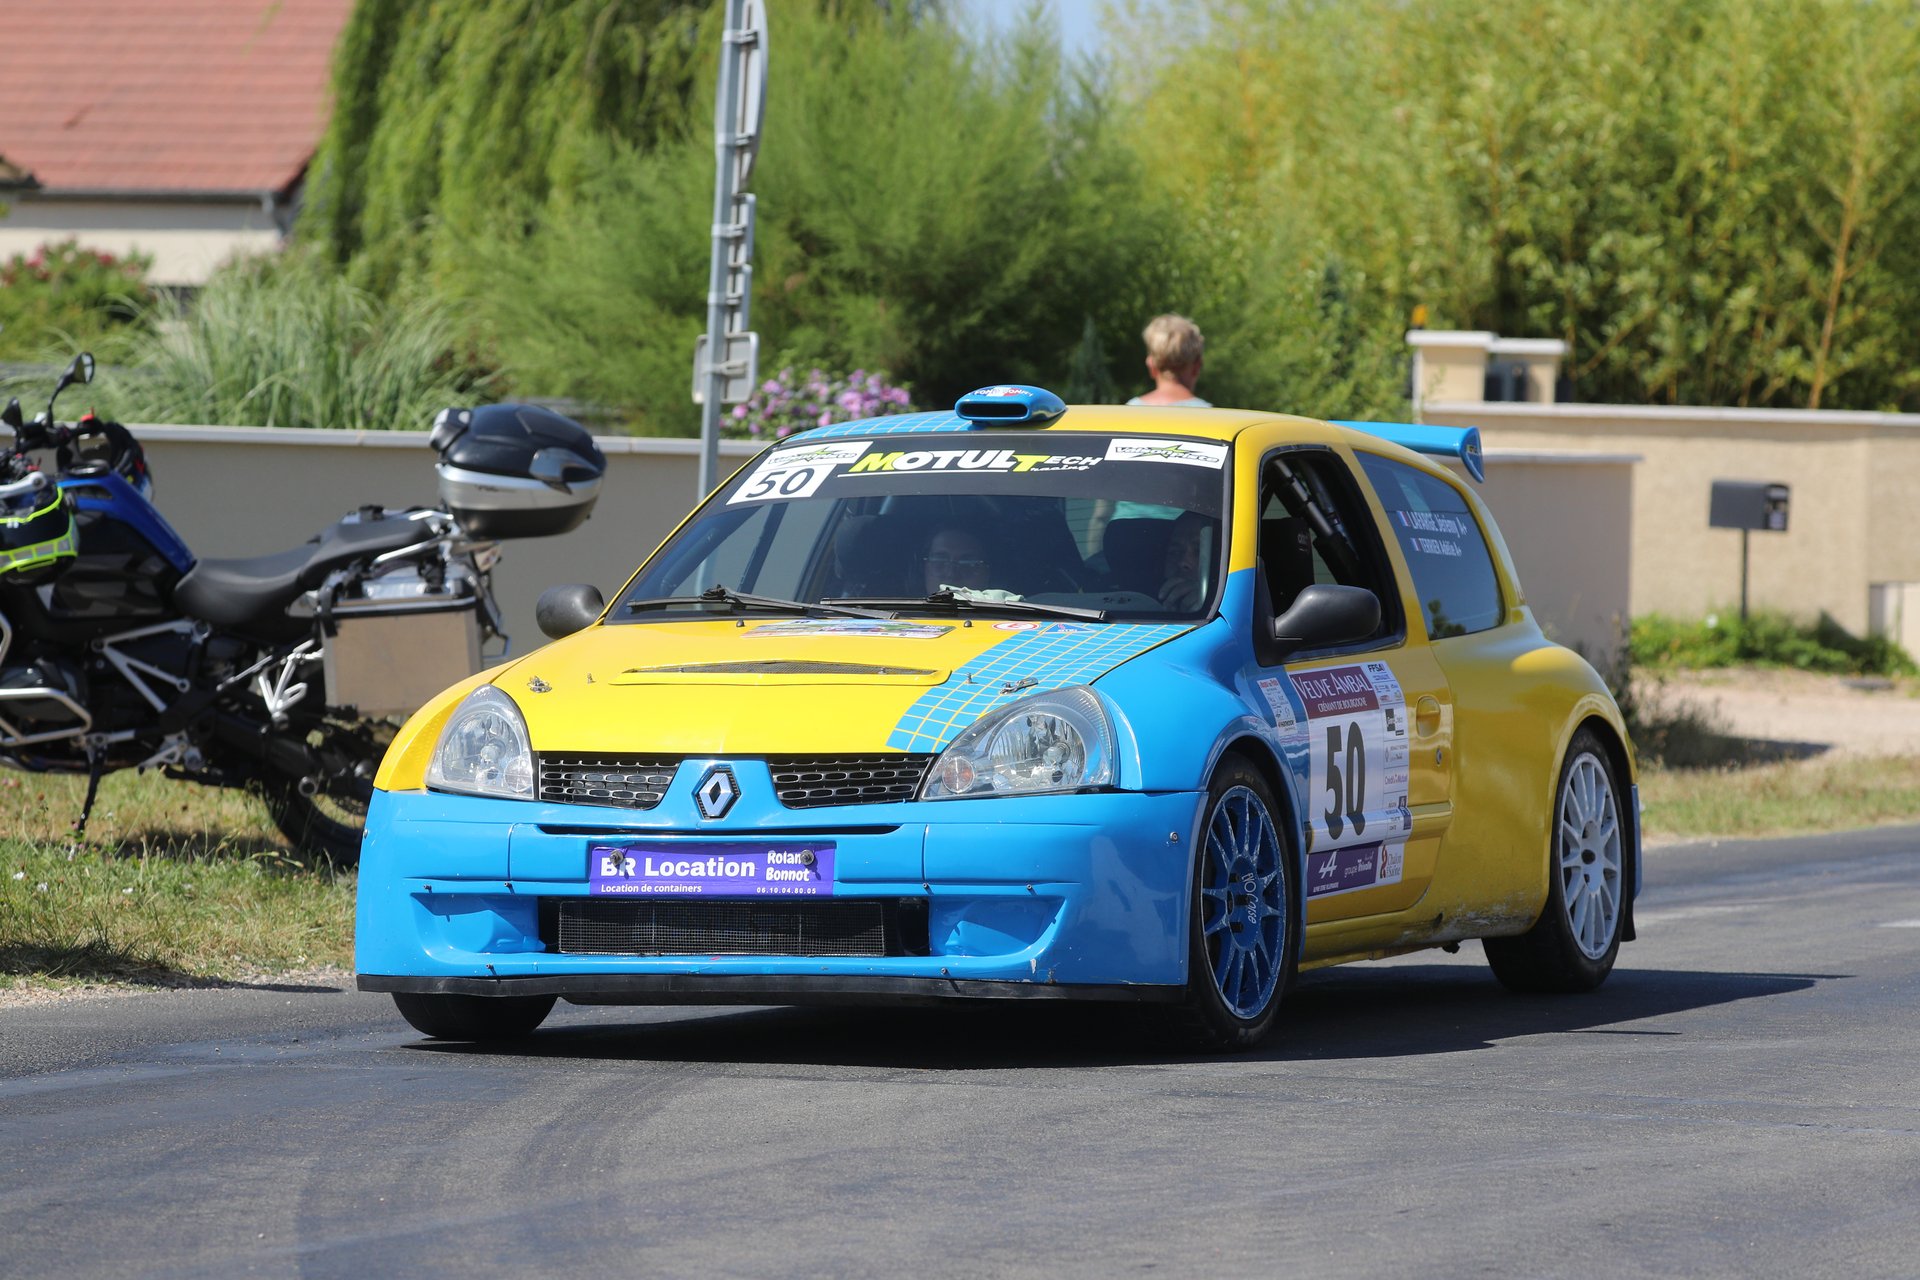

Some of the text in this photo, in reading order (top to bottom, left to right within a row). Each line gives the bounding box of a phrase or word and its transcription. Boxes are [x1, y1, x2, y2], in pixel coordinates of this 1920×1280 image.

[745, 467, 815, 498] 50
[1291, 677, 1337, 700] VEUVE
[1329, 673, 1373, 696] AMBAL
[1342, 697, 1368, 710] BOURGOGNE
[1325, 721, 1365, 840] 50
[600, 856, 756, 877] BR Location
[767, 850, 806, 866] Rolan
[765, 866, 810, 883] Bonnot
[601, 883, 702, 894] Location de containers
